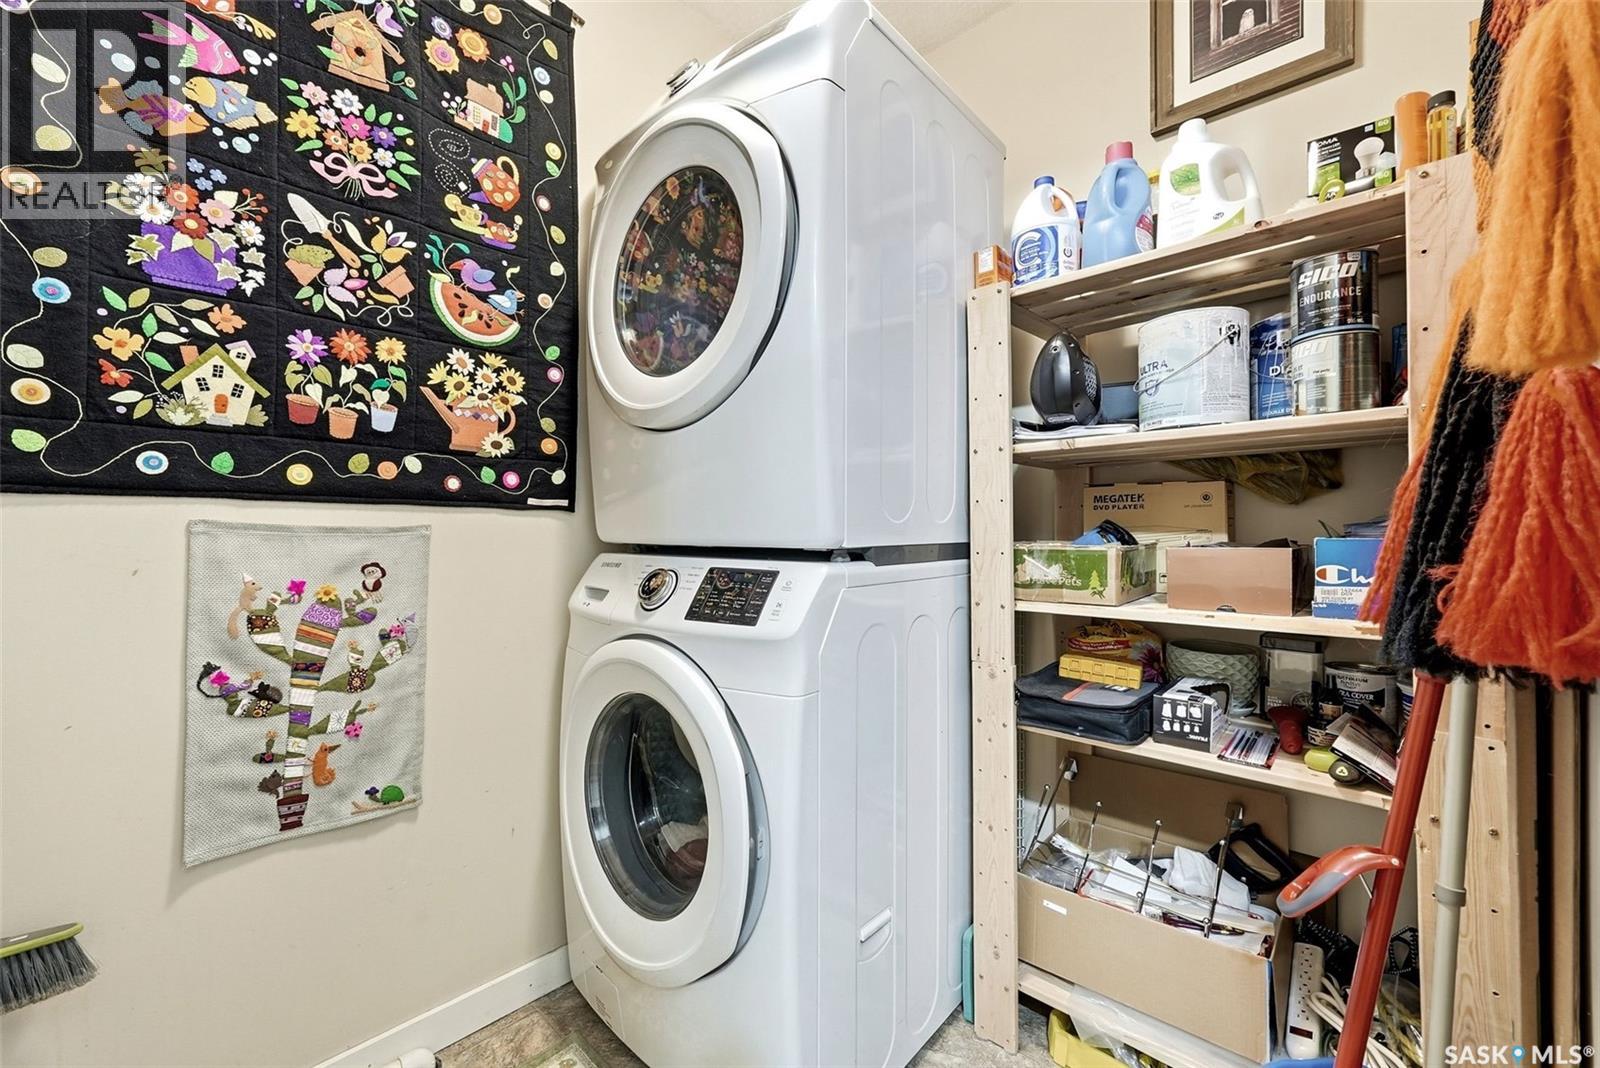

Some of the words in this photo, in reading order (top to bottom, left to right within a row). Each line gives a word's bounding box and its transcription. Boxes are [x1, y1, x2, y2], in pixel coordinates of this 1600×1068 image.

[1297, 261, 1359, 290] SICO
[1299, 286, 1362, 307] ENDURANCE
[1093, 493, 1145, 504] MEGATEK
[1112, 503, 1145, 511] PLAYER
[1351, 692, 1375, 701] COVER
